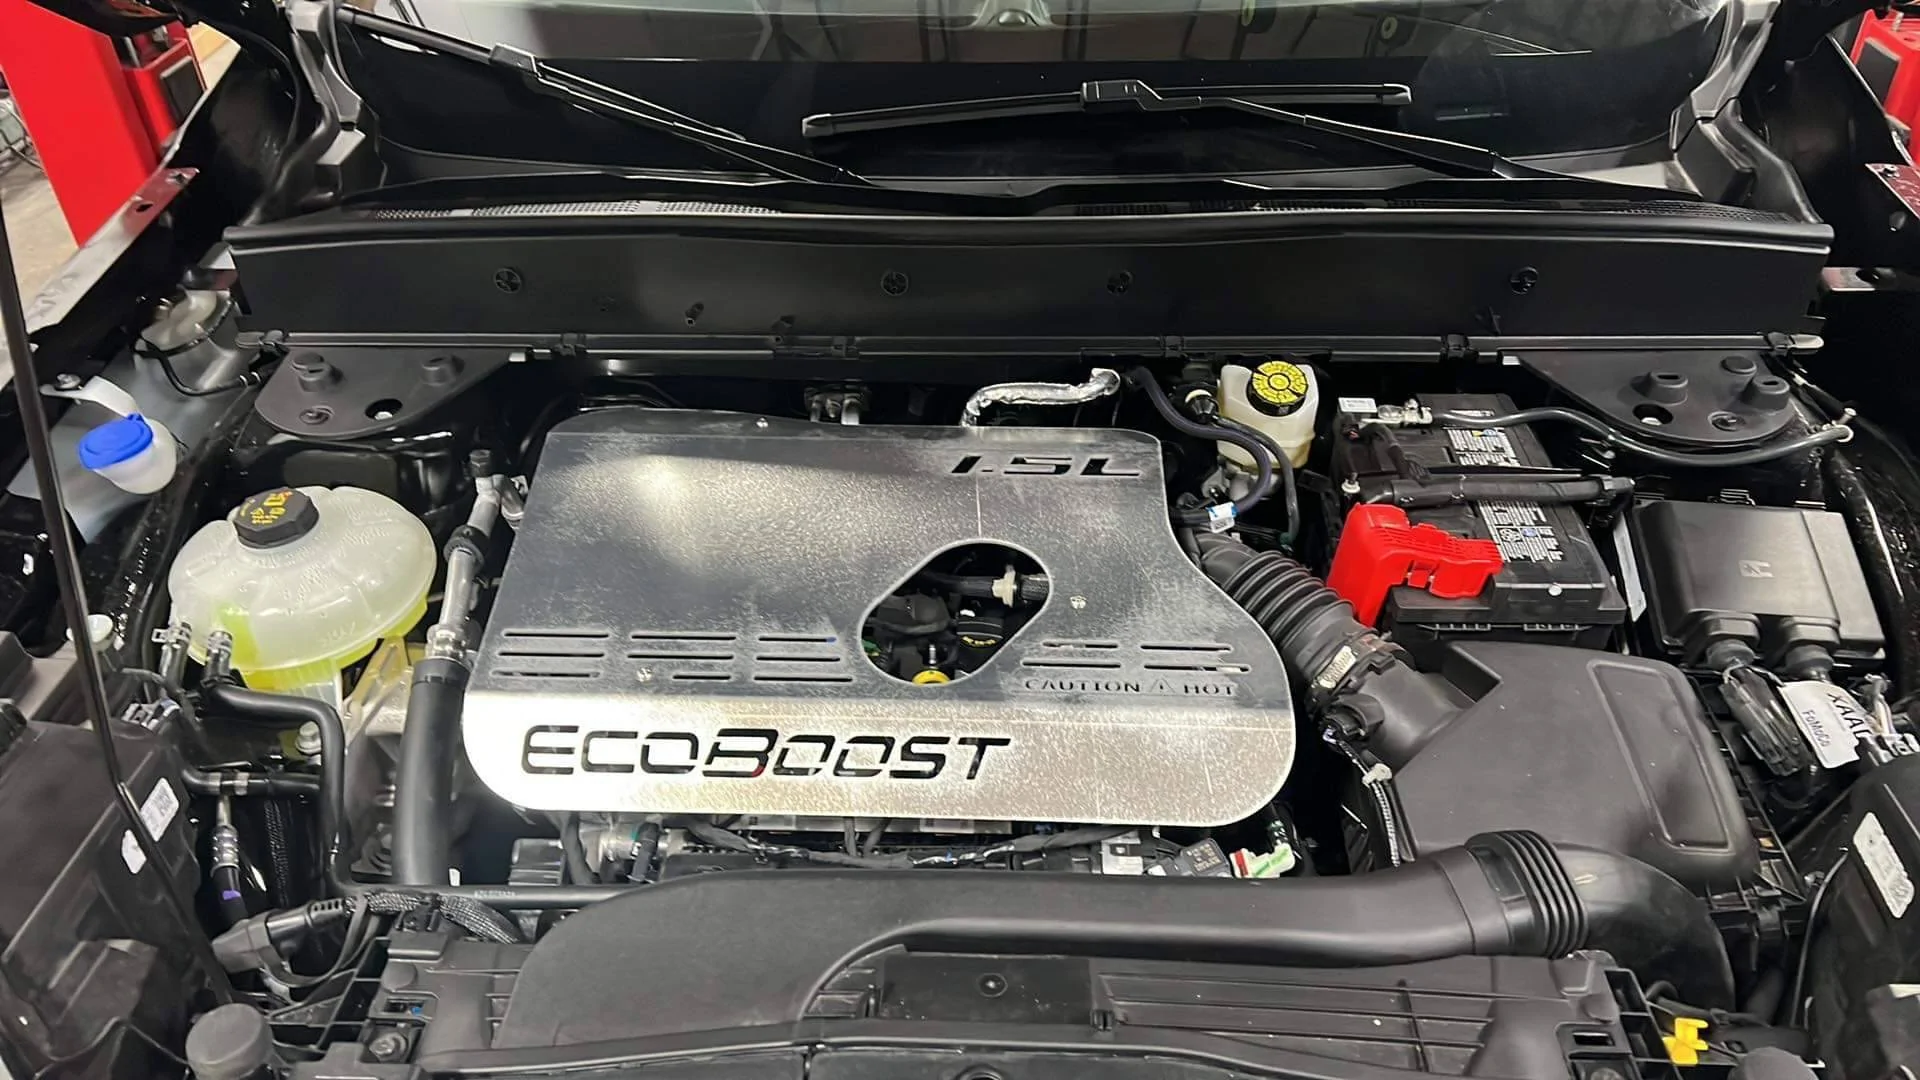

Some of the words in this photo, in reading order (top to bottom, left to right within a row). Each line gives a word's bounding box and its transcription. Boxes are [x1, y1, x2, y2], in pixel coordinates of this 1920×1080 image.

[951, 455, 1140, 475] 1.5L
[1025, 679, 1140, 692] CAUTION
[1183, 683, 1236, 695] HOT
